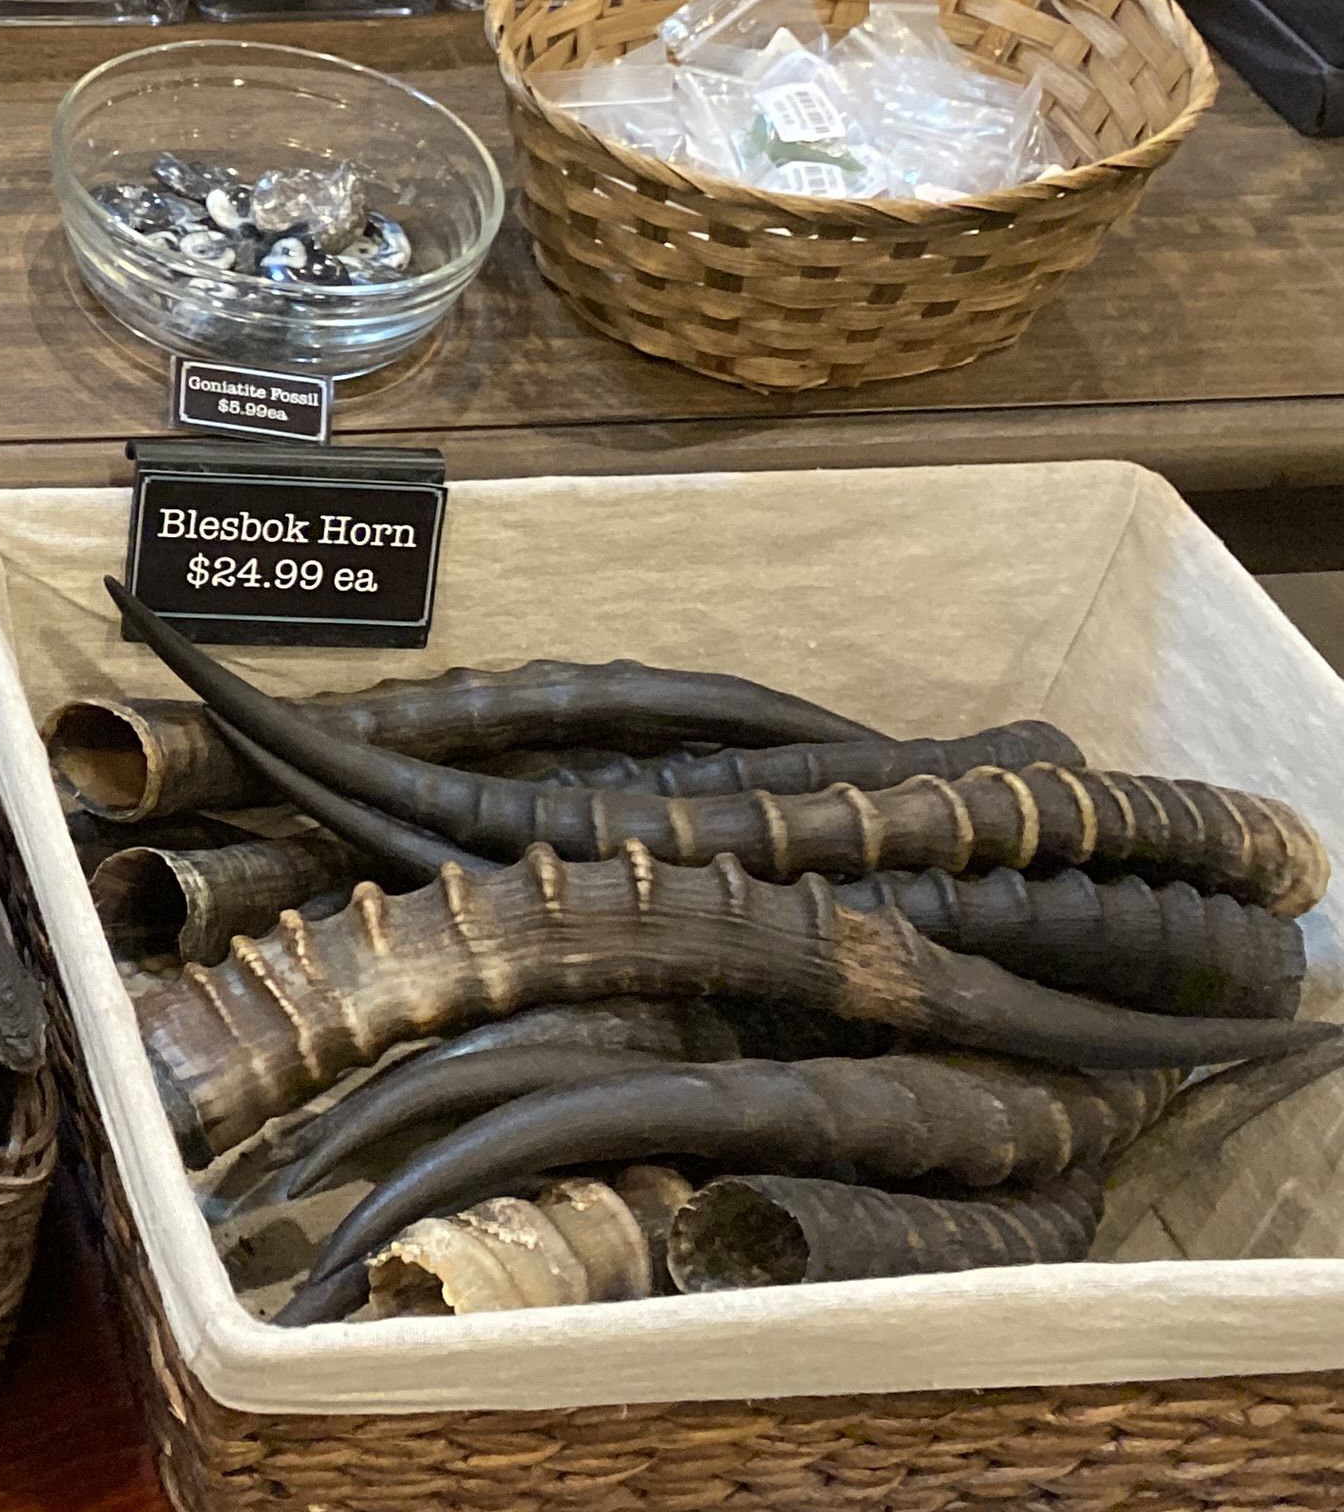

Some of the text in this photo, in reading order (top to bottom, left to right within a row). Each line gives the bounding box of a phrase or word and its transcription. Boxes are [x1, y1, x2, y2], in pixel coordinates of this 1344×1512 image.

[188, 376, 319, 407] Goniatite Fossil
[217, 398, 289, 421] $5.99ea
[157, 508, 417, 548] Blesbok Horn
[186, 552, 379, 593] $24.99 ea
